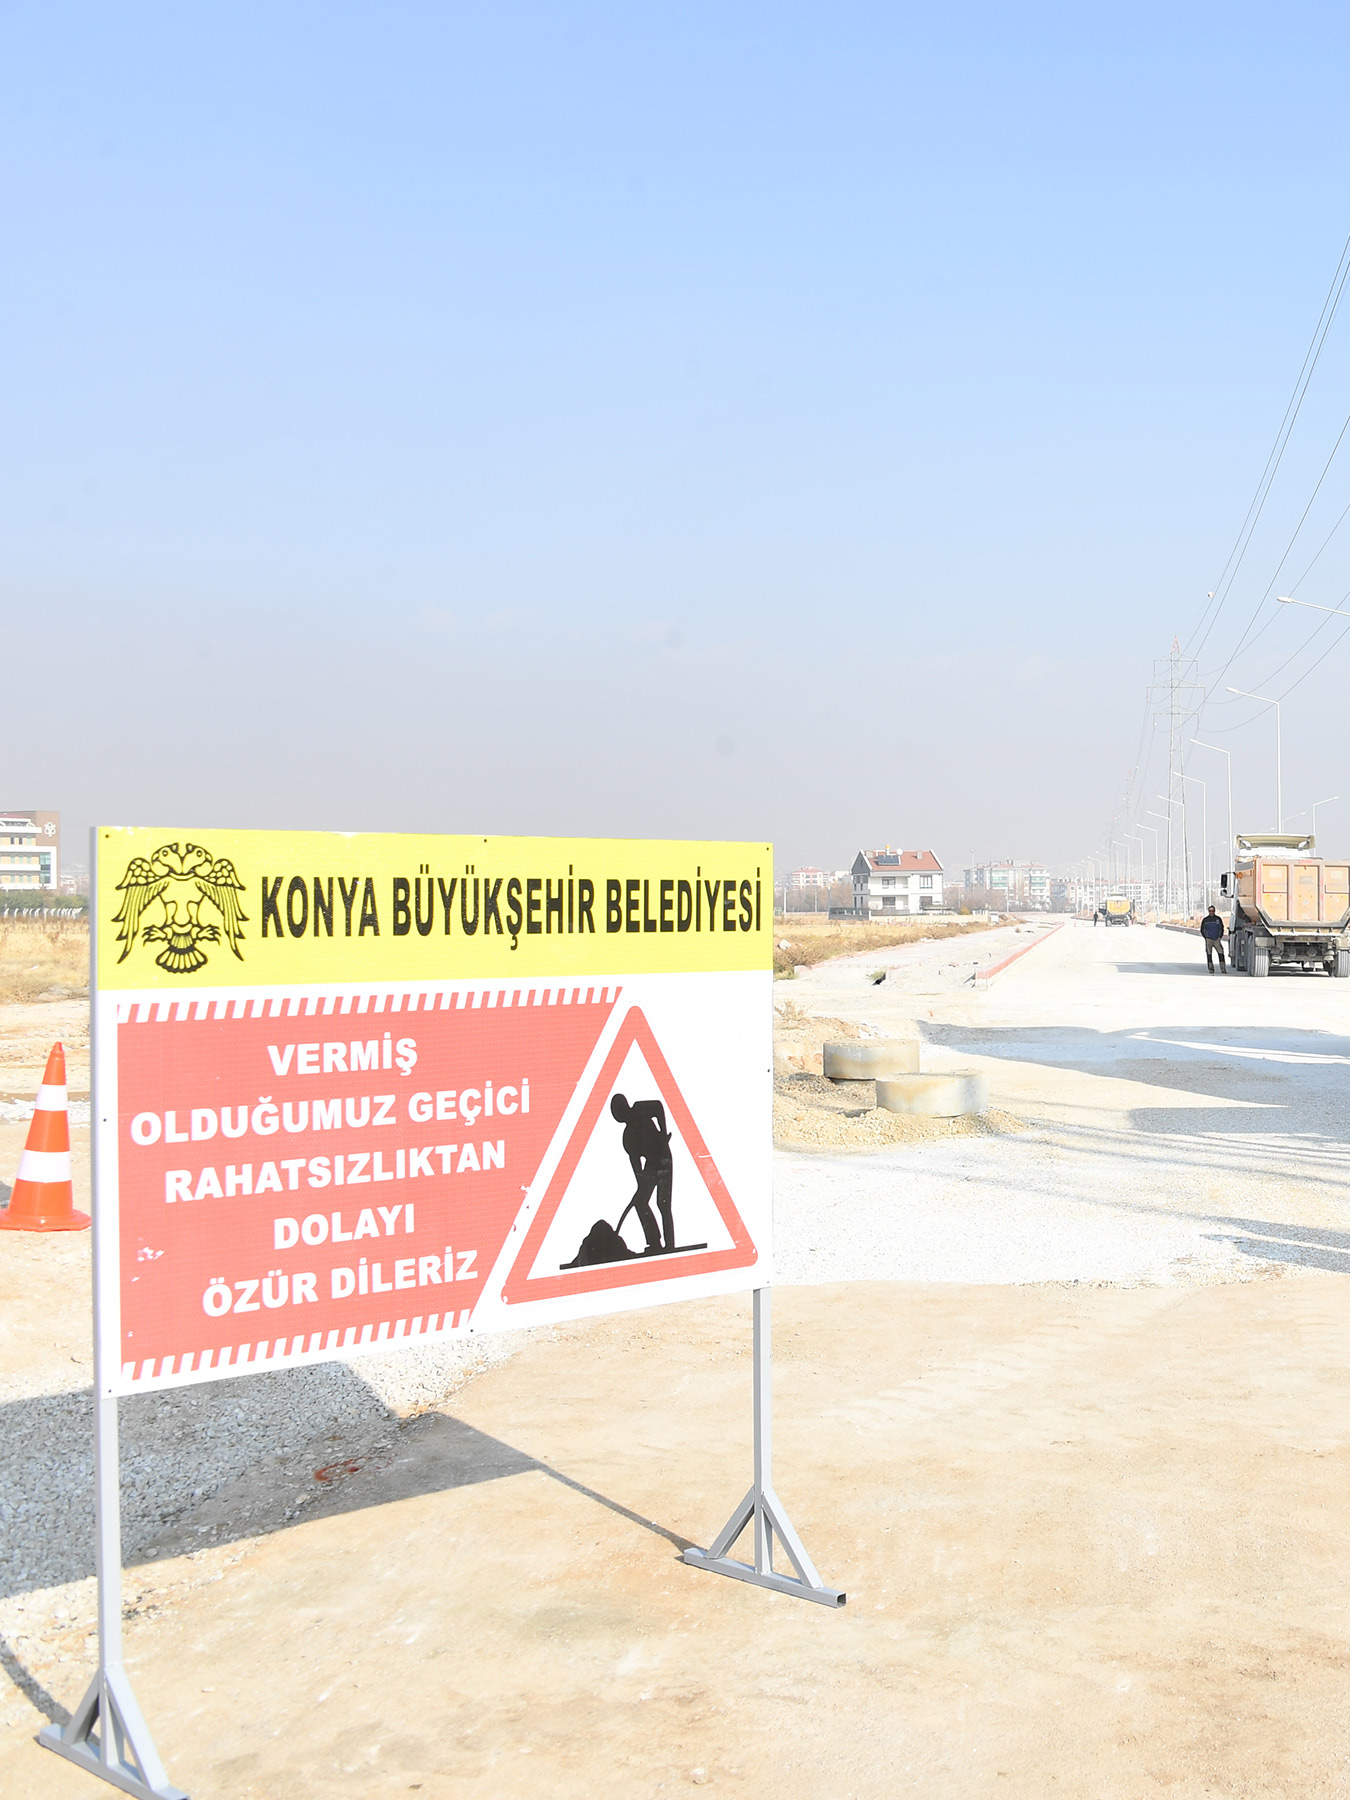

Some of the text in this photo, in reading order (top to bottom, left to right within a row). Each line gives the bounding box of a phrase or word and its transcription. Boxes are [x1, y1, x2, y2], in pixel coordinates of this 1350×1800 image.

[261, 864, 761, 950] KONYA BÜYÜKŞEHİR BELEDİYESİ
[267, 1032, 418, 1077] VERMİŞ
[131, 1078, 530, 1146] OLDUĞUMUZ GEÇİCİ
[164, 1140, 506, 1203] RAHATSIZLIKTAN
[274, 1203, 415, 1250] DOLAYI
[203, 1246, 479, 1317] ÖZÜR DİLERİZ
